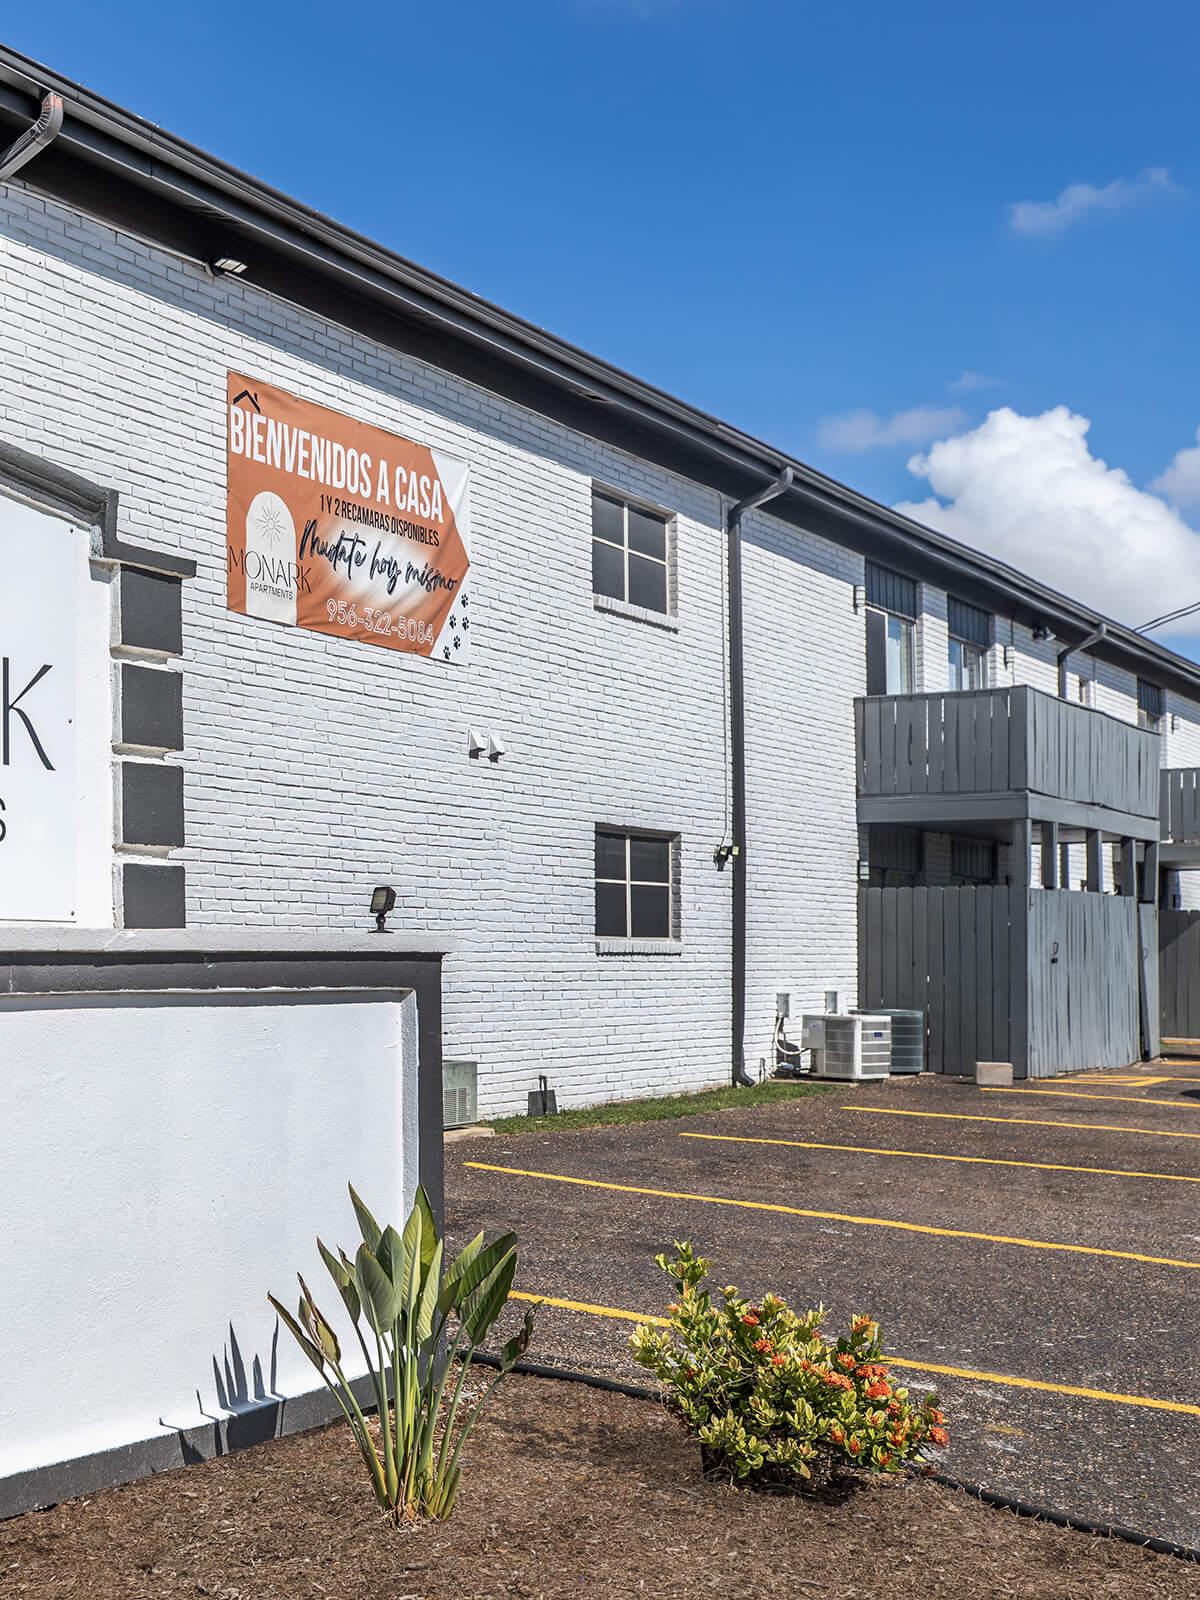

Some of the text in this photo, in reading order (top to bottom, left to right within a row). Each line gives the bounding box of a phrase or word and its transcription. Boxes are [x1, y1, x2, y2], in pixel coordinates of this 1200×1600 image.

[230, 403, 445, 524] BIENVENIDOS A CASA
[319, 494, 440, 547] 1 Y 2 RECAMARAS DISPONIBLES
[228, 545, 313, 594] MONARK
[299, 518, 458, 595] Mudate hoy mismo
[250, 582, 295, 601] APARTMENTS
